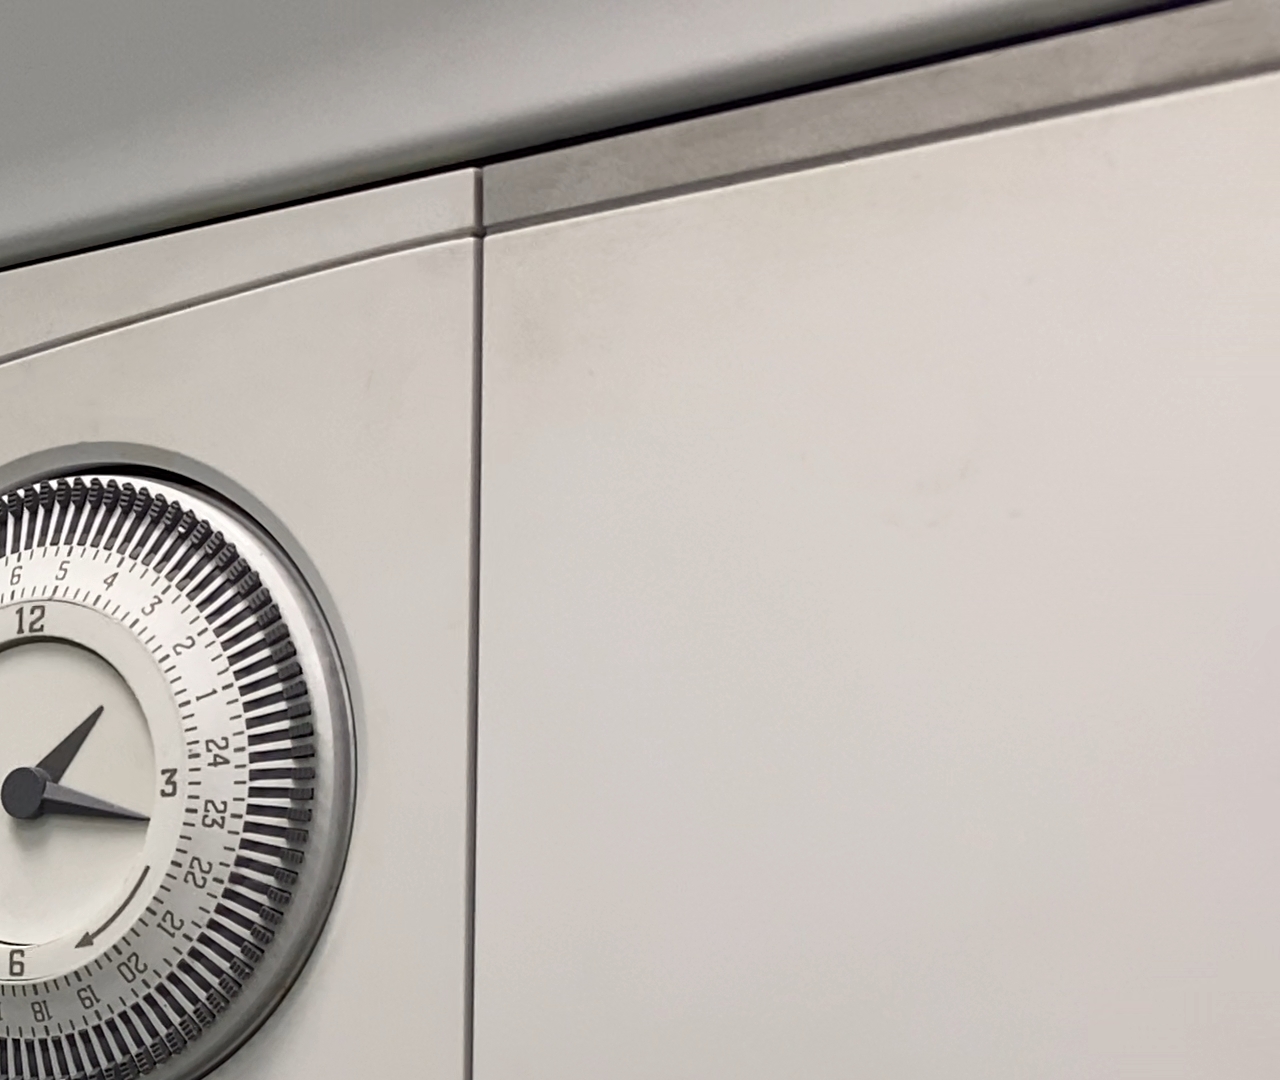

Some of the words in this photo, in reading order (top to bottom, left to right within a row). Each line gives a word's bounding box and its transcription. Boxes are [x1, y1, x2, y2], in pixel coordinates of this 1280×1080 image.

[10, 565, 23, 586] 6
[55, 560, 70, 581] 5
[103, 572, 119, 591] 4
[140, 595, 163, 616] 3
[15, 605, 46, 635] 12
[172, 635, 196, 656] 2
[195, 687, 218, 702] 1
[205, 736, 230, 768] 24
[159, 768, 178, 798] 3
[201, 799, 228, 830] 23
[183, 855, 213, 890] 22
[156, 909, 185, 939] 21
[8, 949, 26, 977] 6
[116, 951, 149, 984] 20
[76, 984, 102, 1010] 19
[31, 1000, 53, 1023] 18
